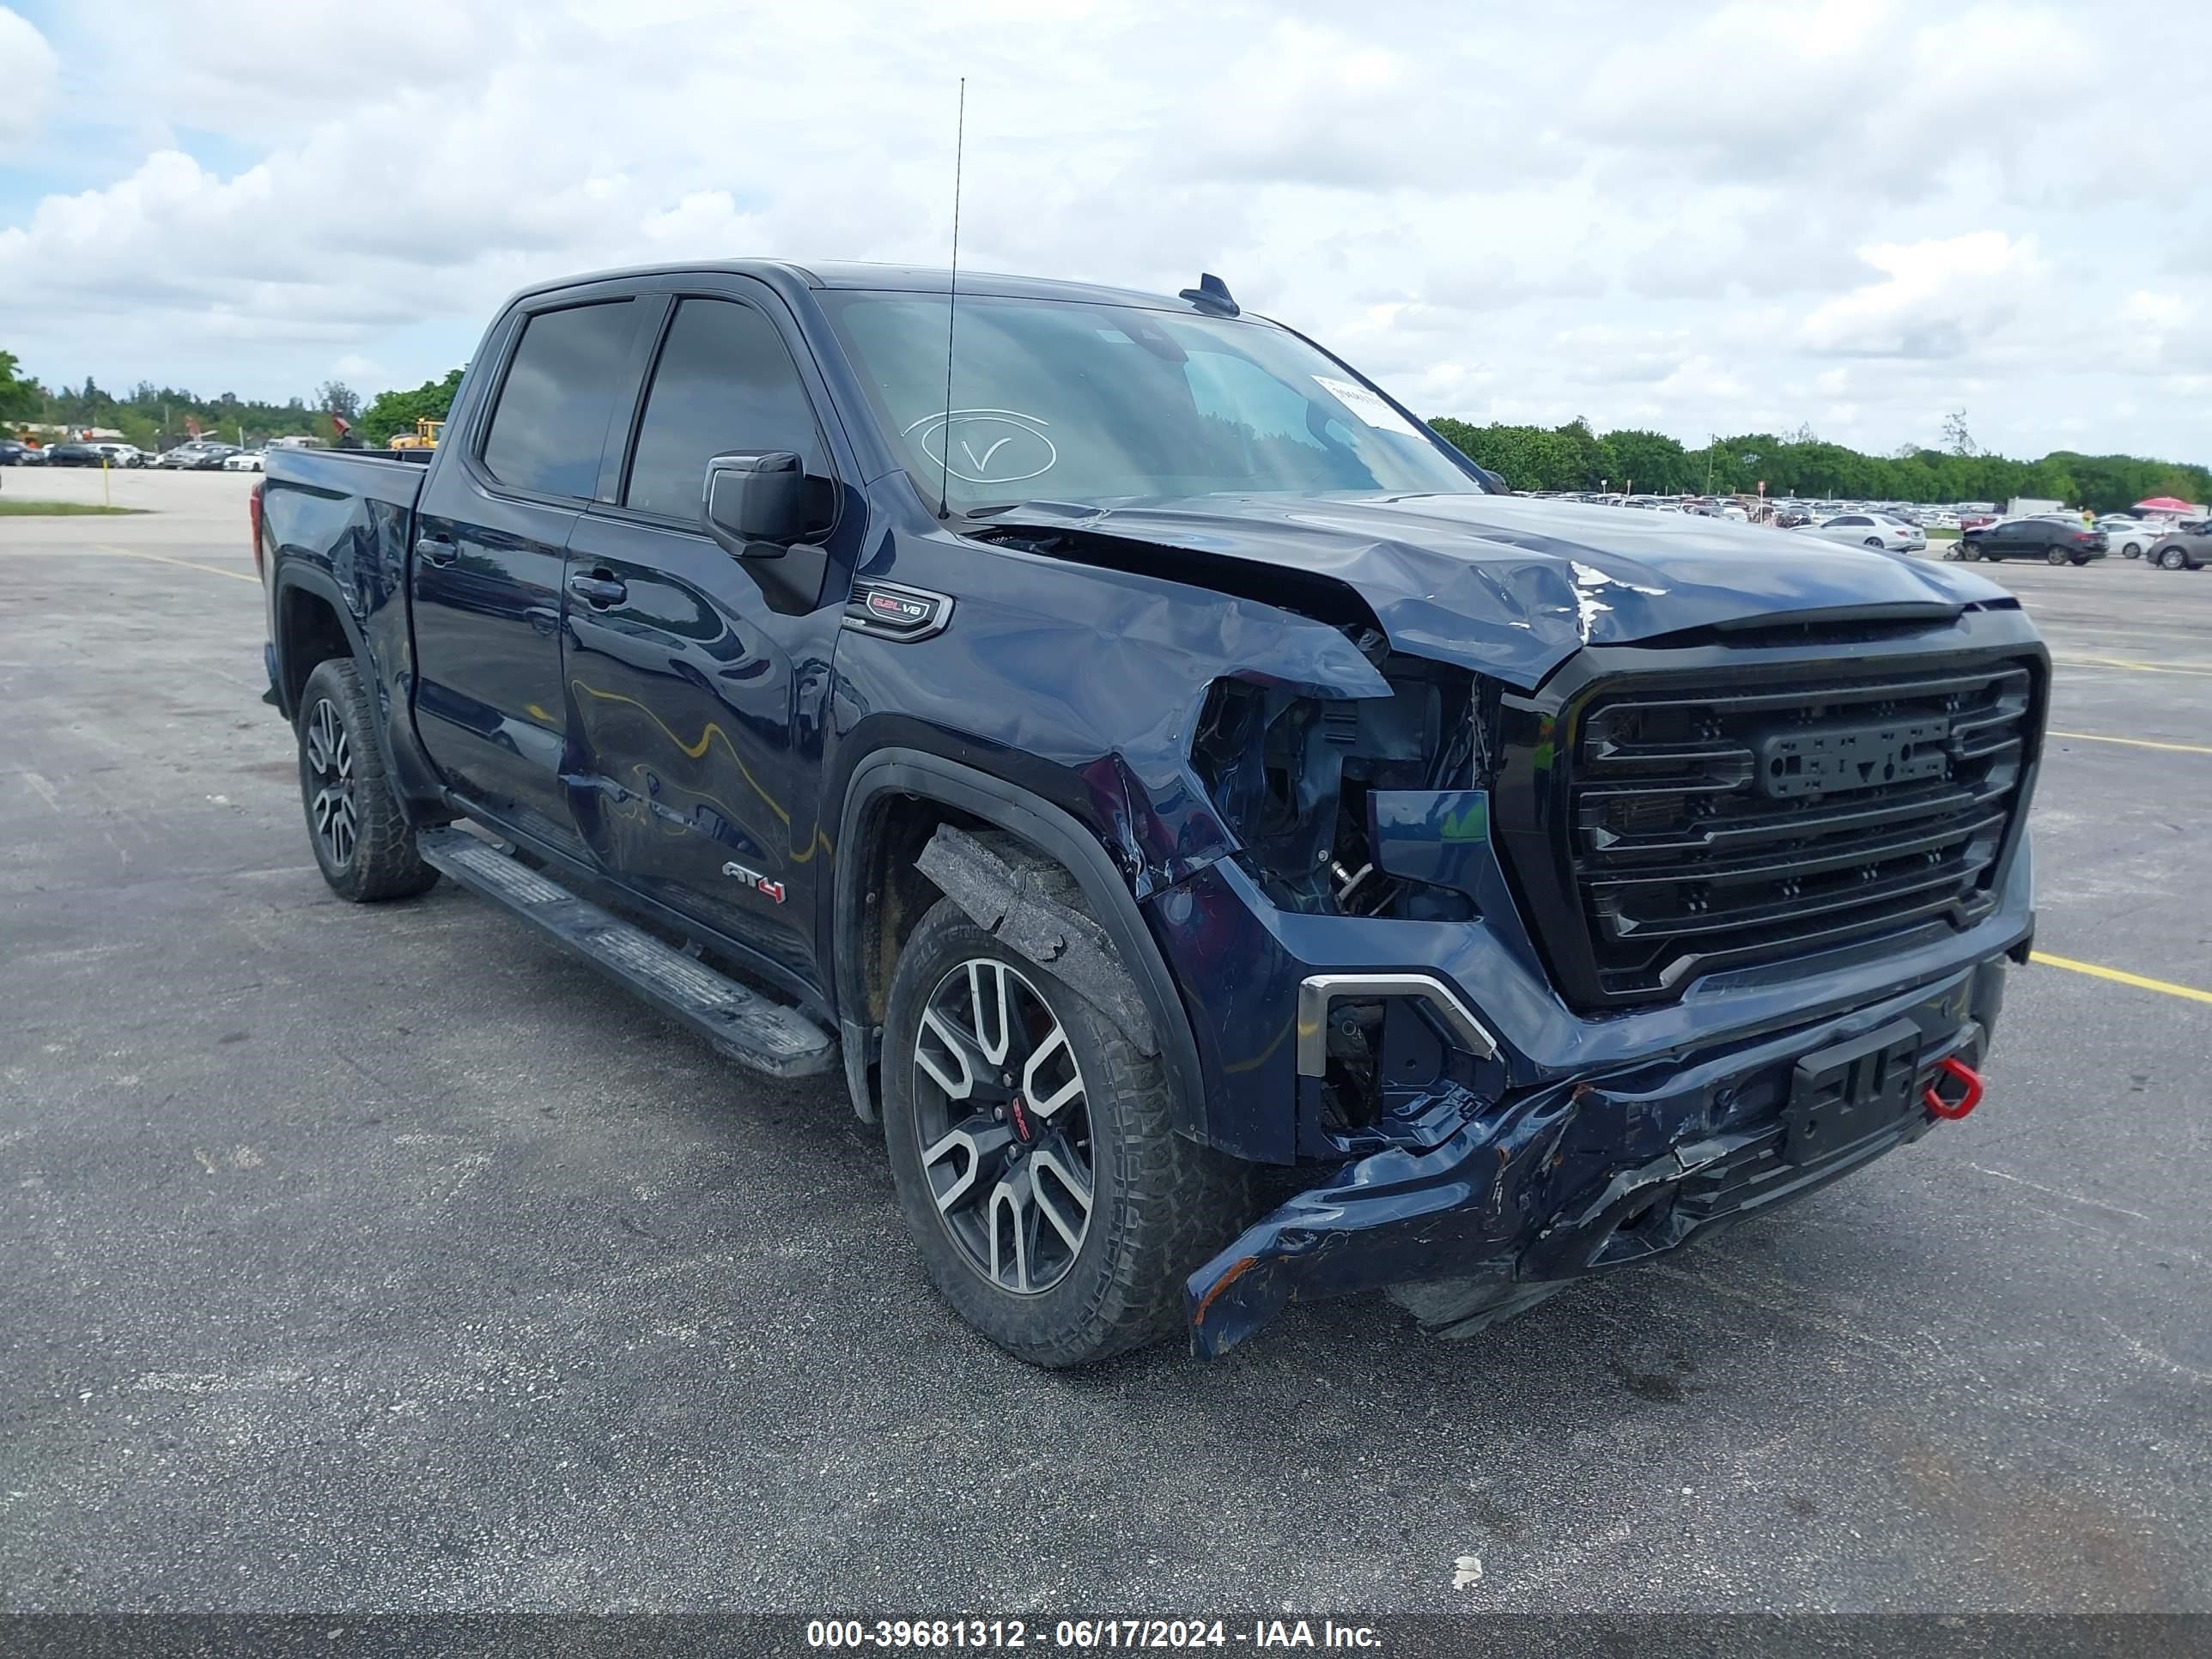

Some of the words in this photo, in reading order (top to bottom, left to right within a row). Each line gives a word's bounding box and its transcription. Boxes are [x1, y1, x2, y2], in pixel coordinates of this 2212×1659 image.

[902, 604, 921, 616] V8
[721, 860, 787, 905] AT4
[1012, 1097, 1031, 1141] GMC
